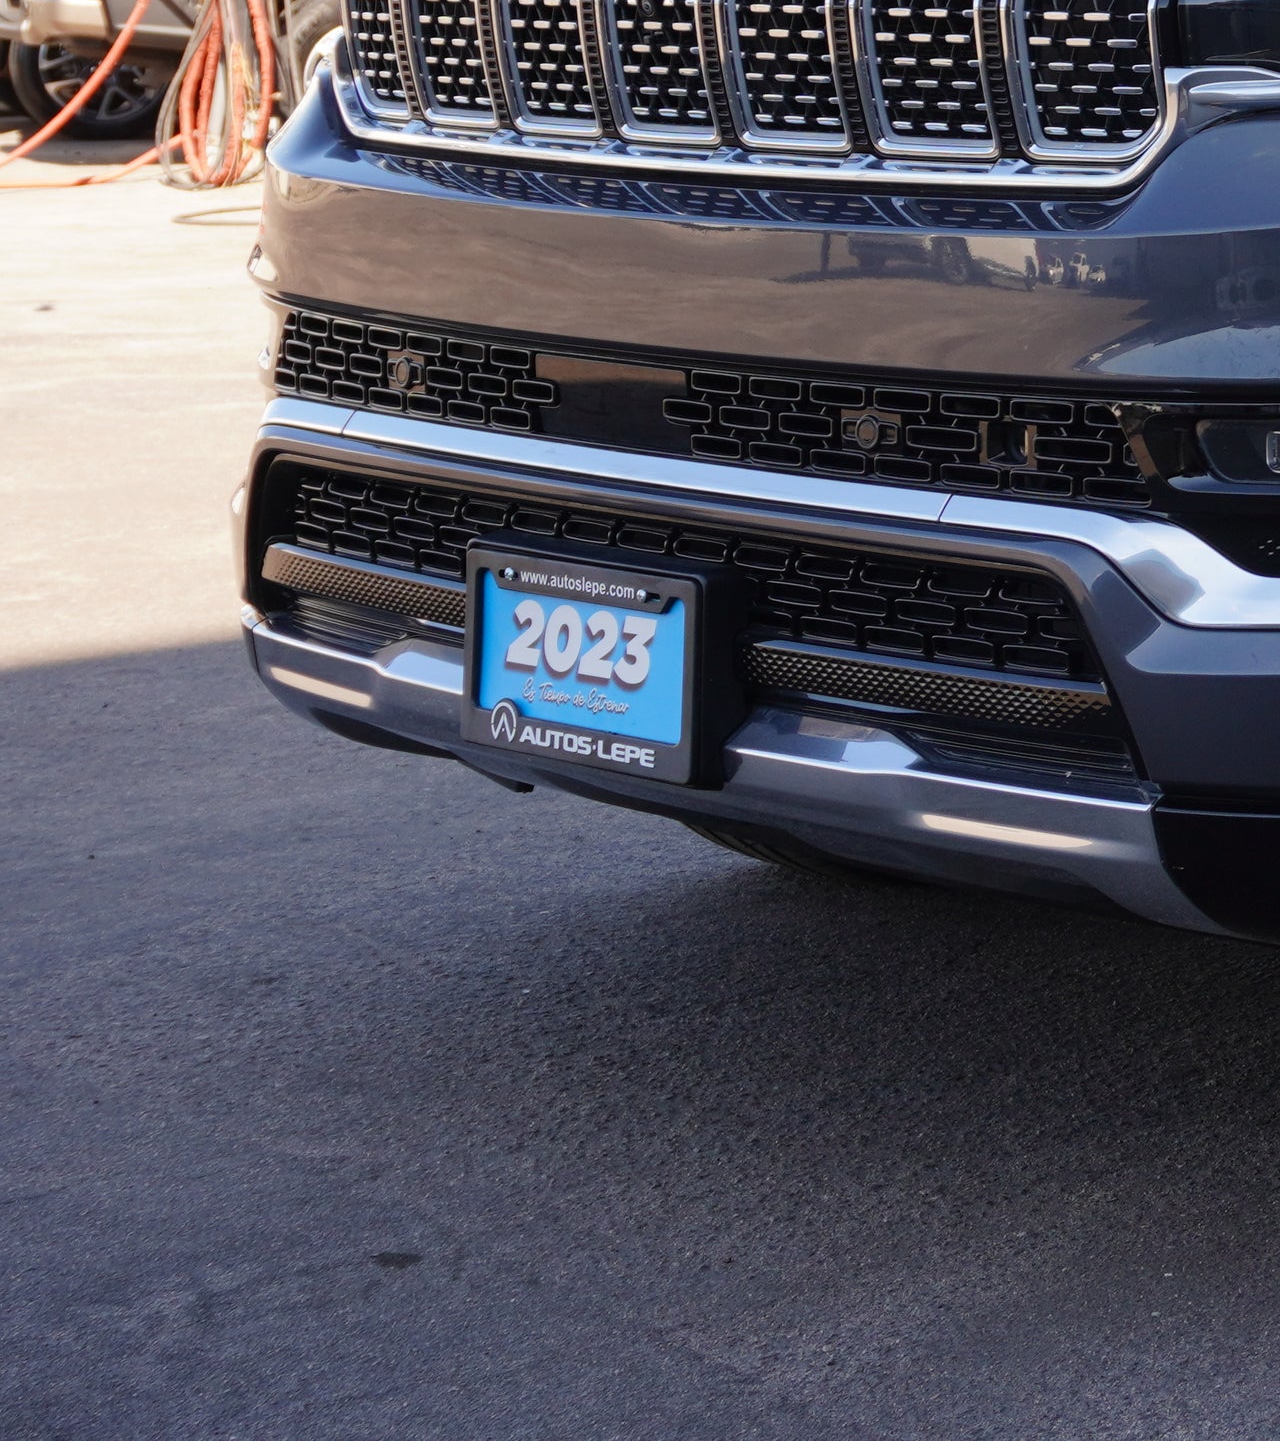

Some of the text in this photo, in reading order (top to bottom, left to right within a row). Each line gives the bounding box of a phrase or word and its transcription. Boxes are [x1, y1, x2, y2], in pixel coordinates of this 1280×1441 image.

[520, 570, 635, 600] www.autoslepe.com
[505, 599, 658, 685] 2023
[523, 676, 630, 714] Es Tiempo de Estrenar
